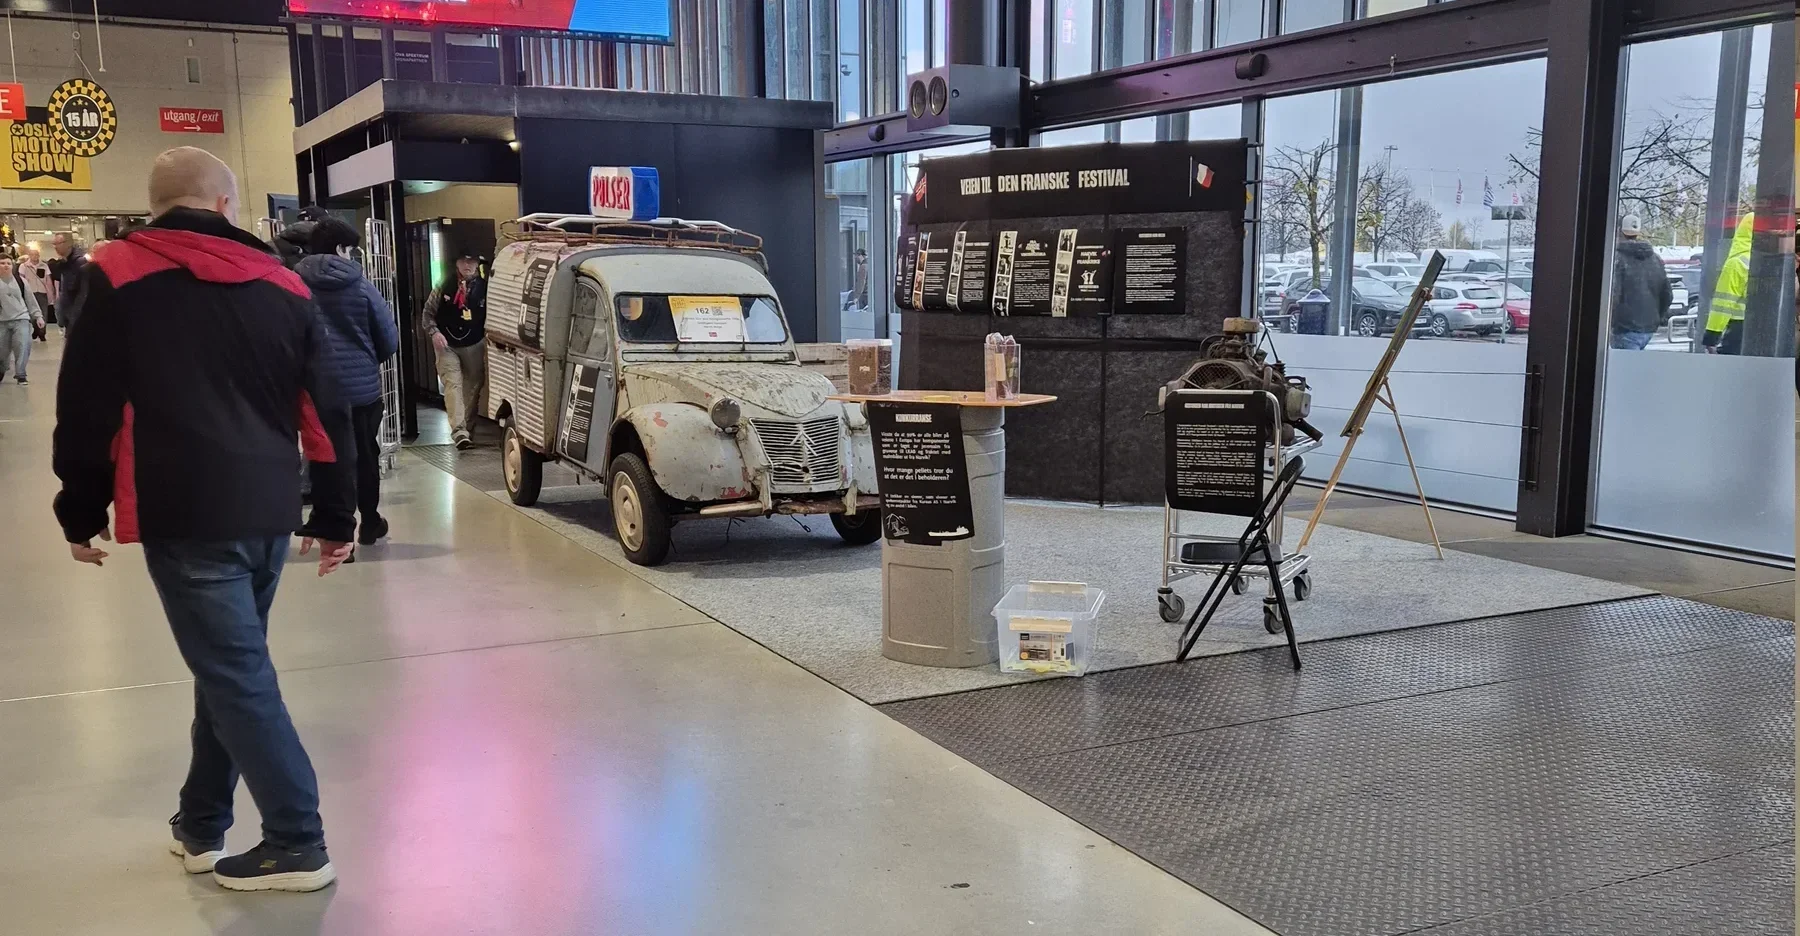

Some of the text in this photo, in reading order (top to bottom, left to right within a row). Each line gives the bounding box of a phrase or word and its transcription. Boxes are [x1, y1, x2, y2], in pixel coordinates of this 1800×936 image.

[66, 108, 98, 128] 15 ÅR
[24, 122, 50, 136] OSL
[12, 153, 74, 172] SHOW
[960, 169, 1130, 196] VEIEN TIL DEN FRANSKE FESTIVAL
